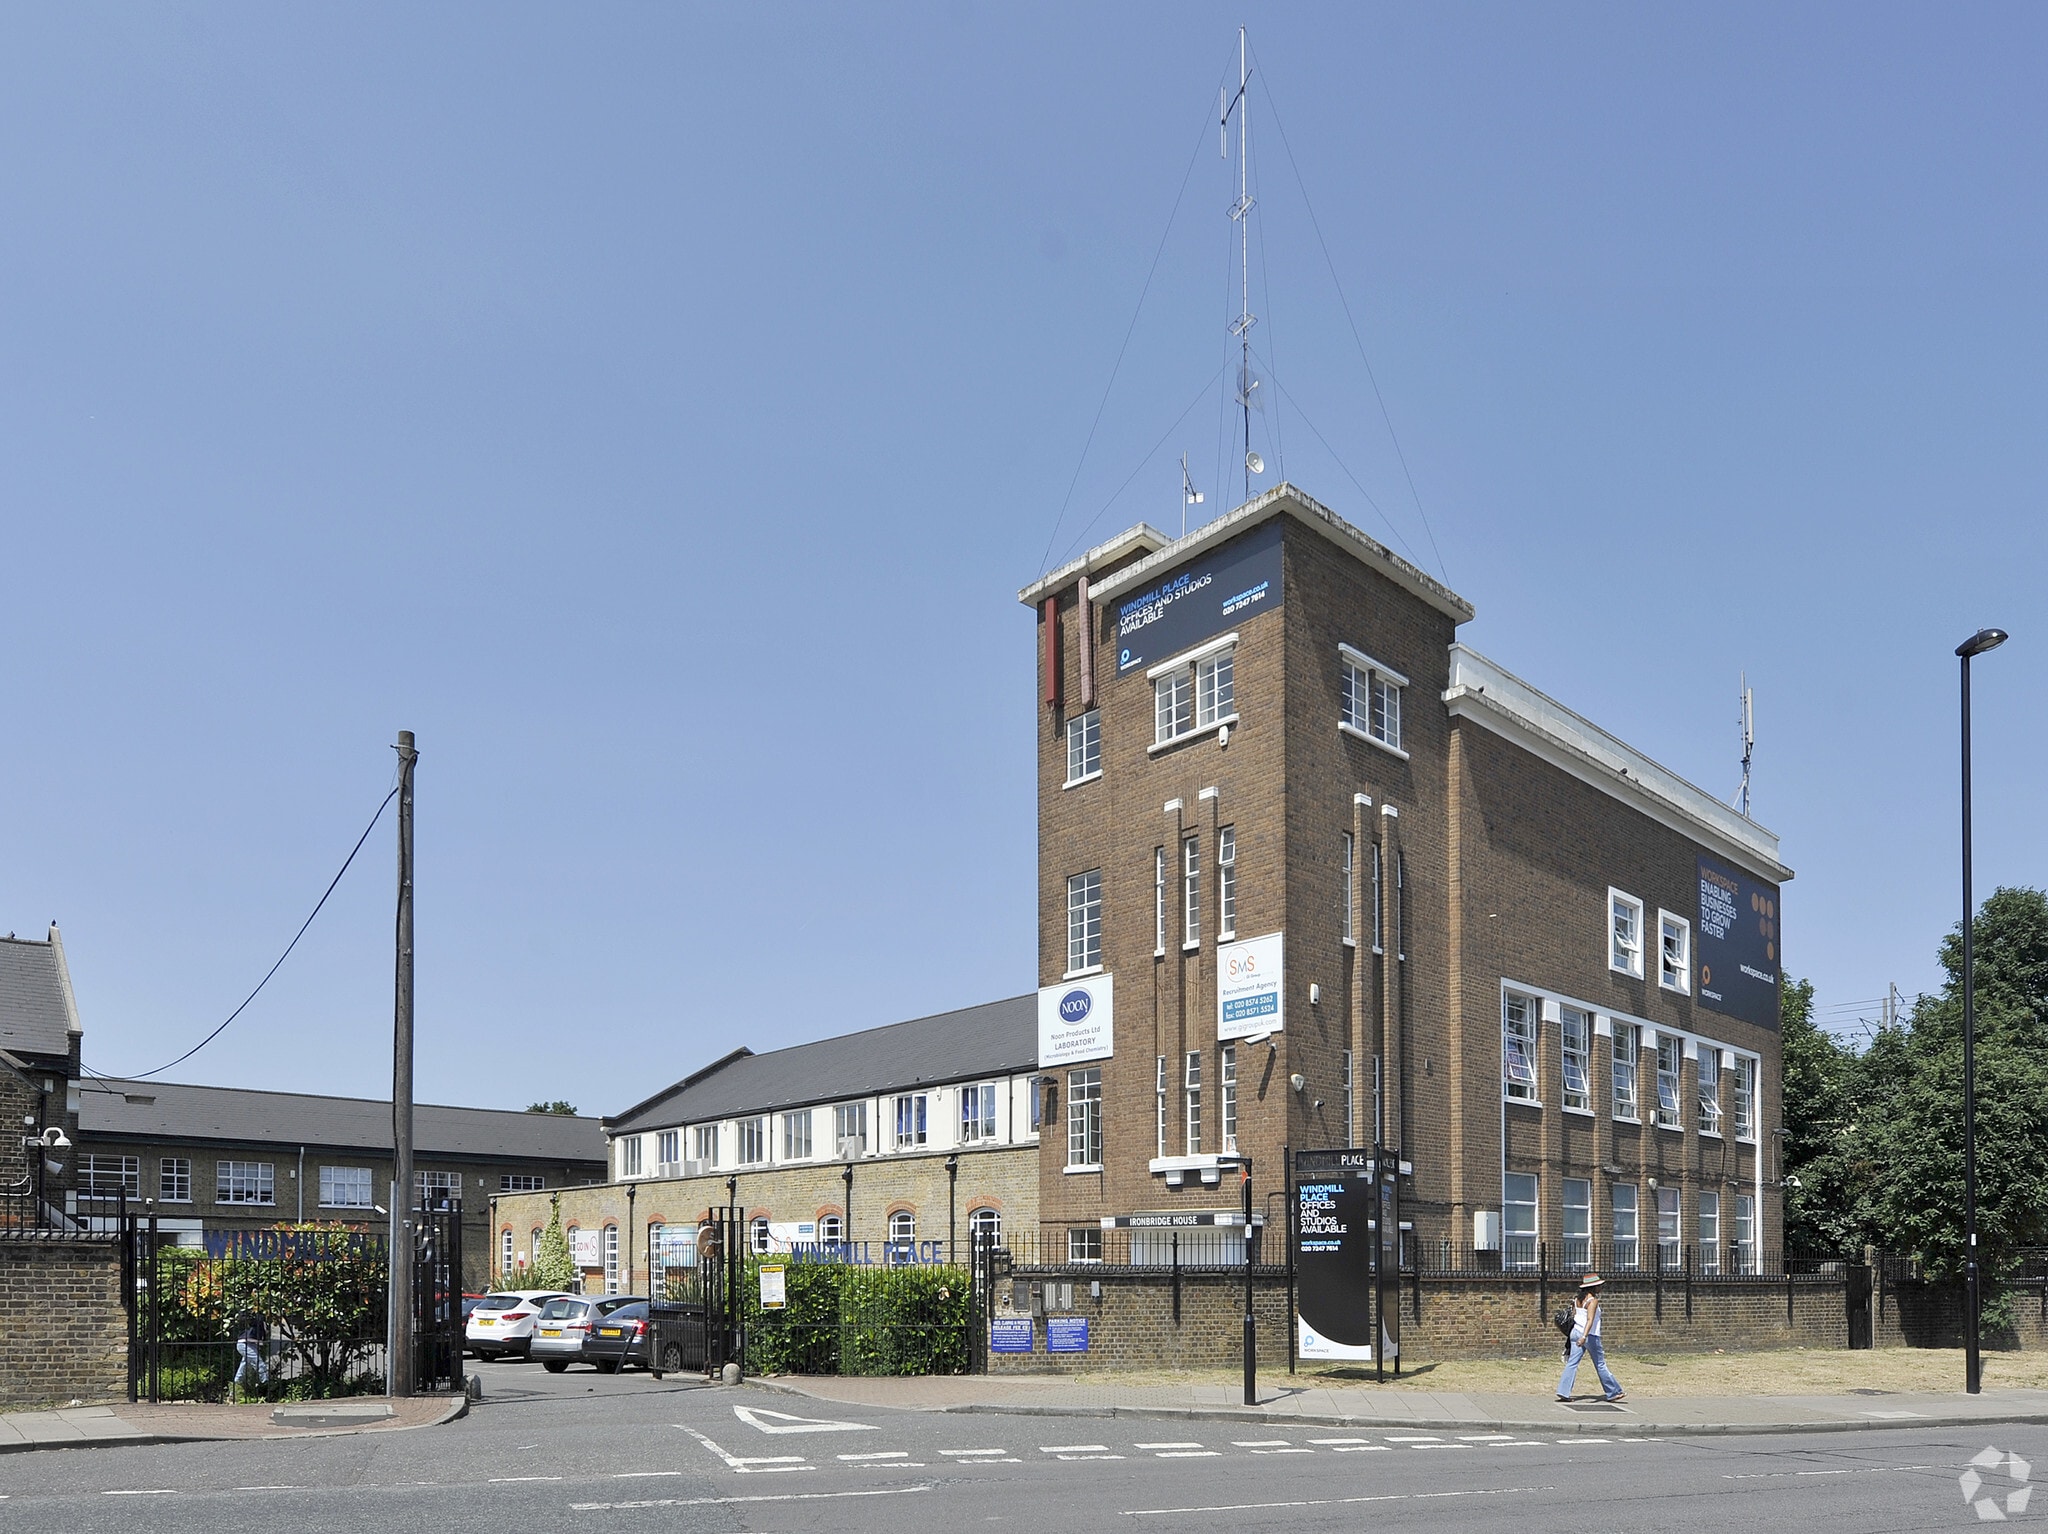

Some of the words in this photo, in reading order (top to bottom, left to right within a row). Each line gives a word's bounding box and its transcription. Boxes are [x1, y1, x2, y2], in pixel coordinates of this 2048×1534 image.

[1120, 589, 1161, 616] WINDMILL
[1162, 573, 1190, 595] PLACE
[1120, 603, 1153, 626] OFFICES
[1154, 593, 1174, 610] AND
[1174, 573, 1212, 600] STUDIOS
[1222, 580, 1269, 607] workspace.co.uk
[1222, 605, 1235, 616] 020
[1120, 607, 1164, 637] AVAILABLE
[1701, 865, 1739, 895] WORKSPACE
[1701, 879, 1732, 904] ENABLING
[1701, 893, 1737, 920] BUSINESSES
[1701, 906, 1711, 920] TO
[1711, 909, 1731, 930] GROW
[1701, 920, 1725, 940] FASTER
[1229, 956, 1255, 975] SMS
[1740, 963, 1775, 985] workspace.co.uk
[1223, 985, 1255, 996] Recruitment
[1256, 981, 1278, 990] Agency
[1234, 1000, 1245, 1009] 020
[1235, 1009, 1246, 1018] 020
[1066, 1028, 1090, 1038] Products
[1055, 1037, 1096, 1050] LABORATORY
[1341, 1154, 1364, 1166] PLACE
[1300, 1184, 1345, 1193] WINDMILL
[1300, 1193, 1329, 1201] PLACE
[1300, 1200, 1336, 1209] OFFICES
[1129, 1216, 1172, 1227] IRONBRIDGE
[1173, 1215, 1198, 1225] HOUSE
[1300, 1209, 1320, 1218] AND
[1300, 1217, 1337, 1226] STUDIOS
[1300, 1224, 1348, 1234] AVAILABLE
[202, 1230, 336, 1261] WINDMILL
[349, 1231, 390, 1262] PLA
[791, 1241, 873, 1264] WINDMILL
[884, 1240, 943, 1264] PLACE
